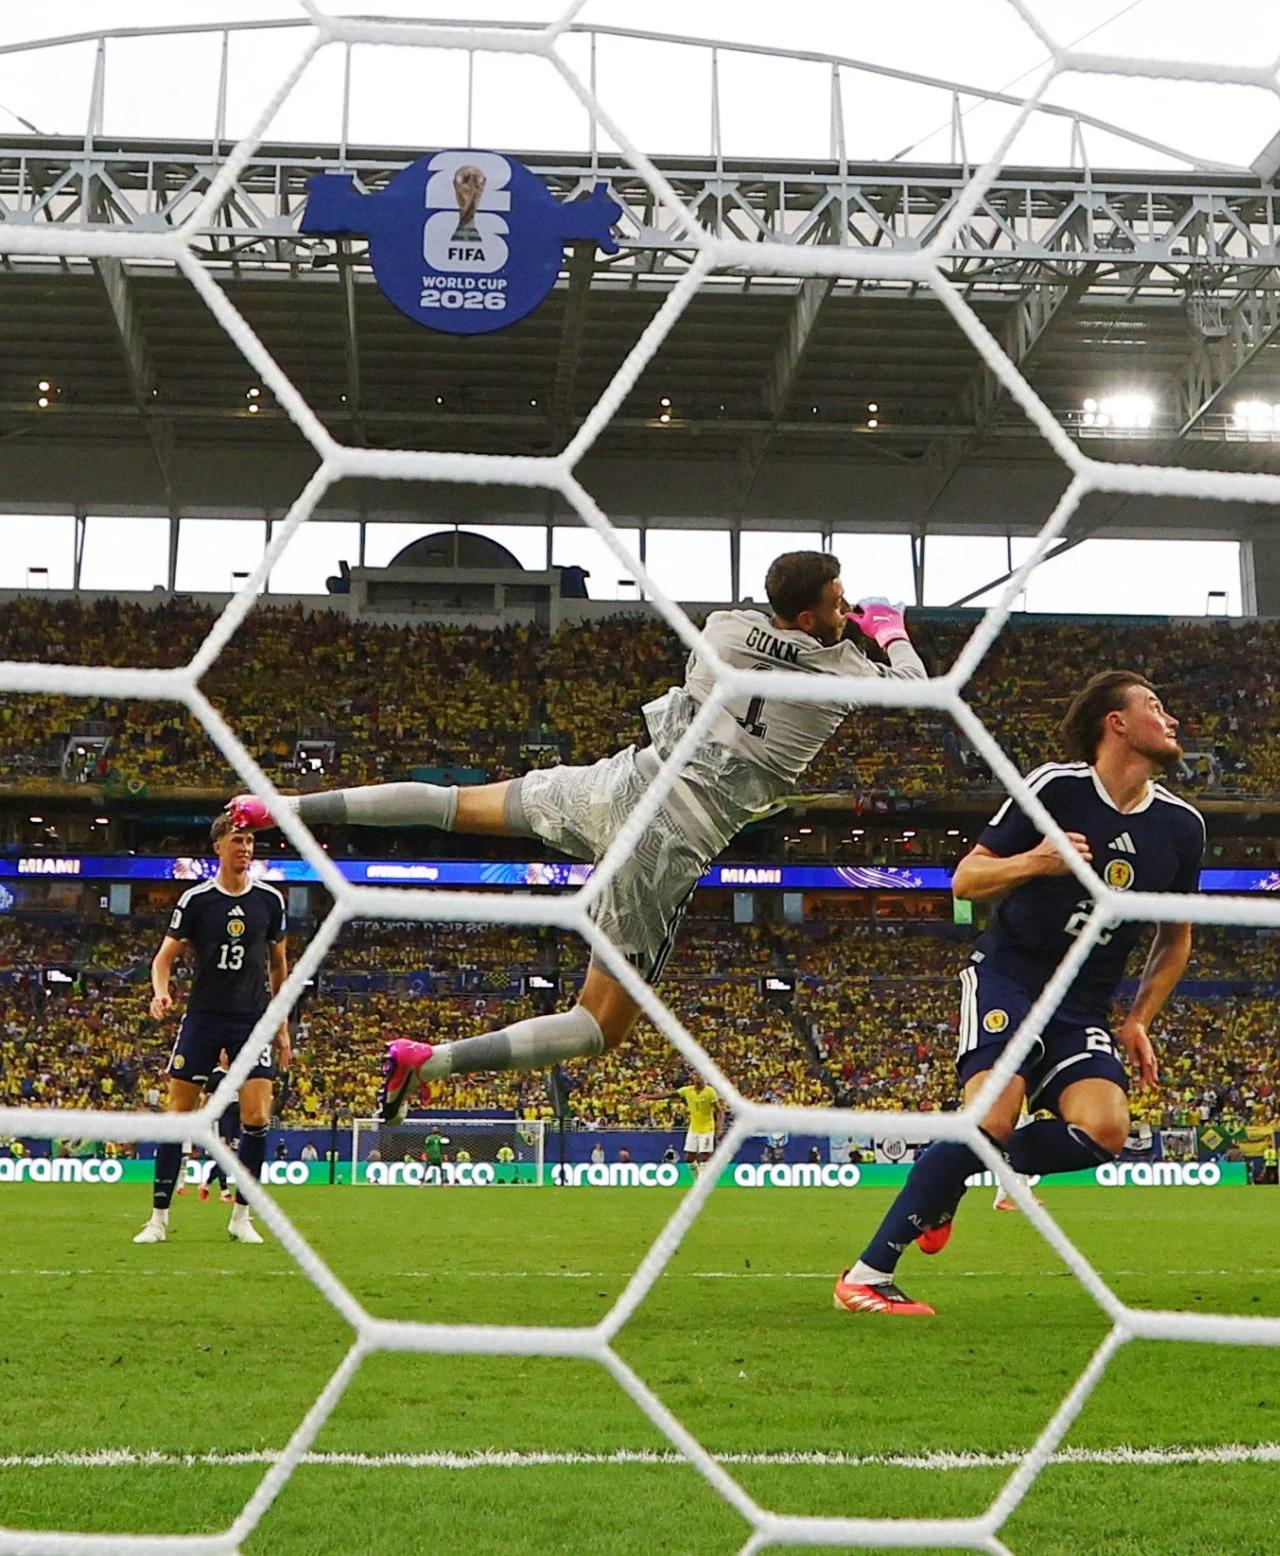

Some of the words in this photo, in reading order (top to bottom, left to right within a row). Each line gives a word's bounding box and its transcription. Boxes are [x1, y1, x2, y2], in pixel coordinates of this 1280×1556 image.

[447, 247, 486, 262] FIFA
[422, 276, 474, 290] WORLD
[478, 278, 508, 291] CUP
[420, 291, 506, 311] 2026
[745, 627, 801, 664] GUNN
[17, 858, 81, 874] MIAMI
[720, 868, 782, 884] MIAMI
[217, 943, 245, 971] 13
[551, 1163, 679, 1187] aramco
[734, 1163, 861, 1188] aramco
[1095, 1161, 1221, 1187] aramco
